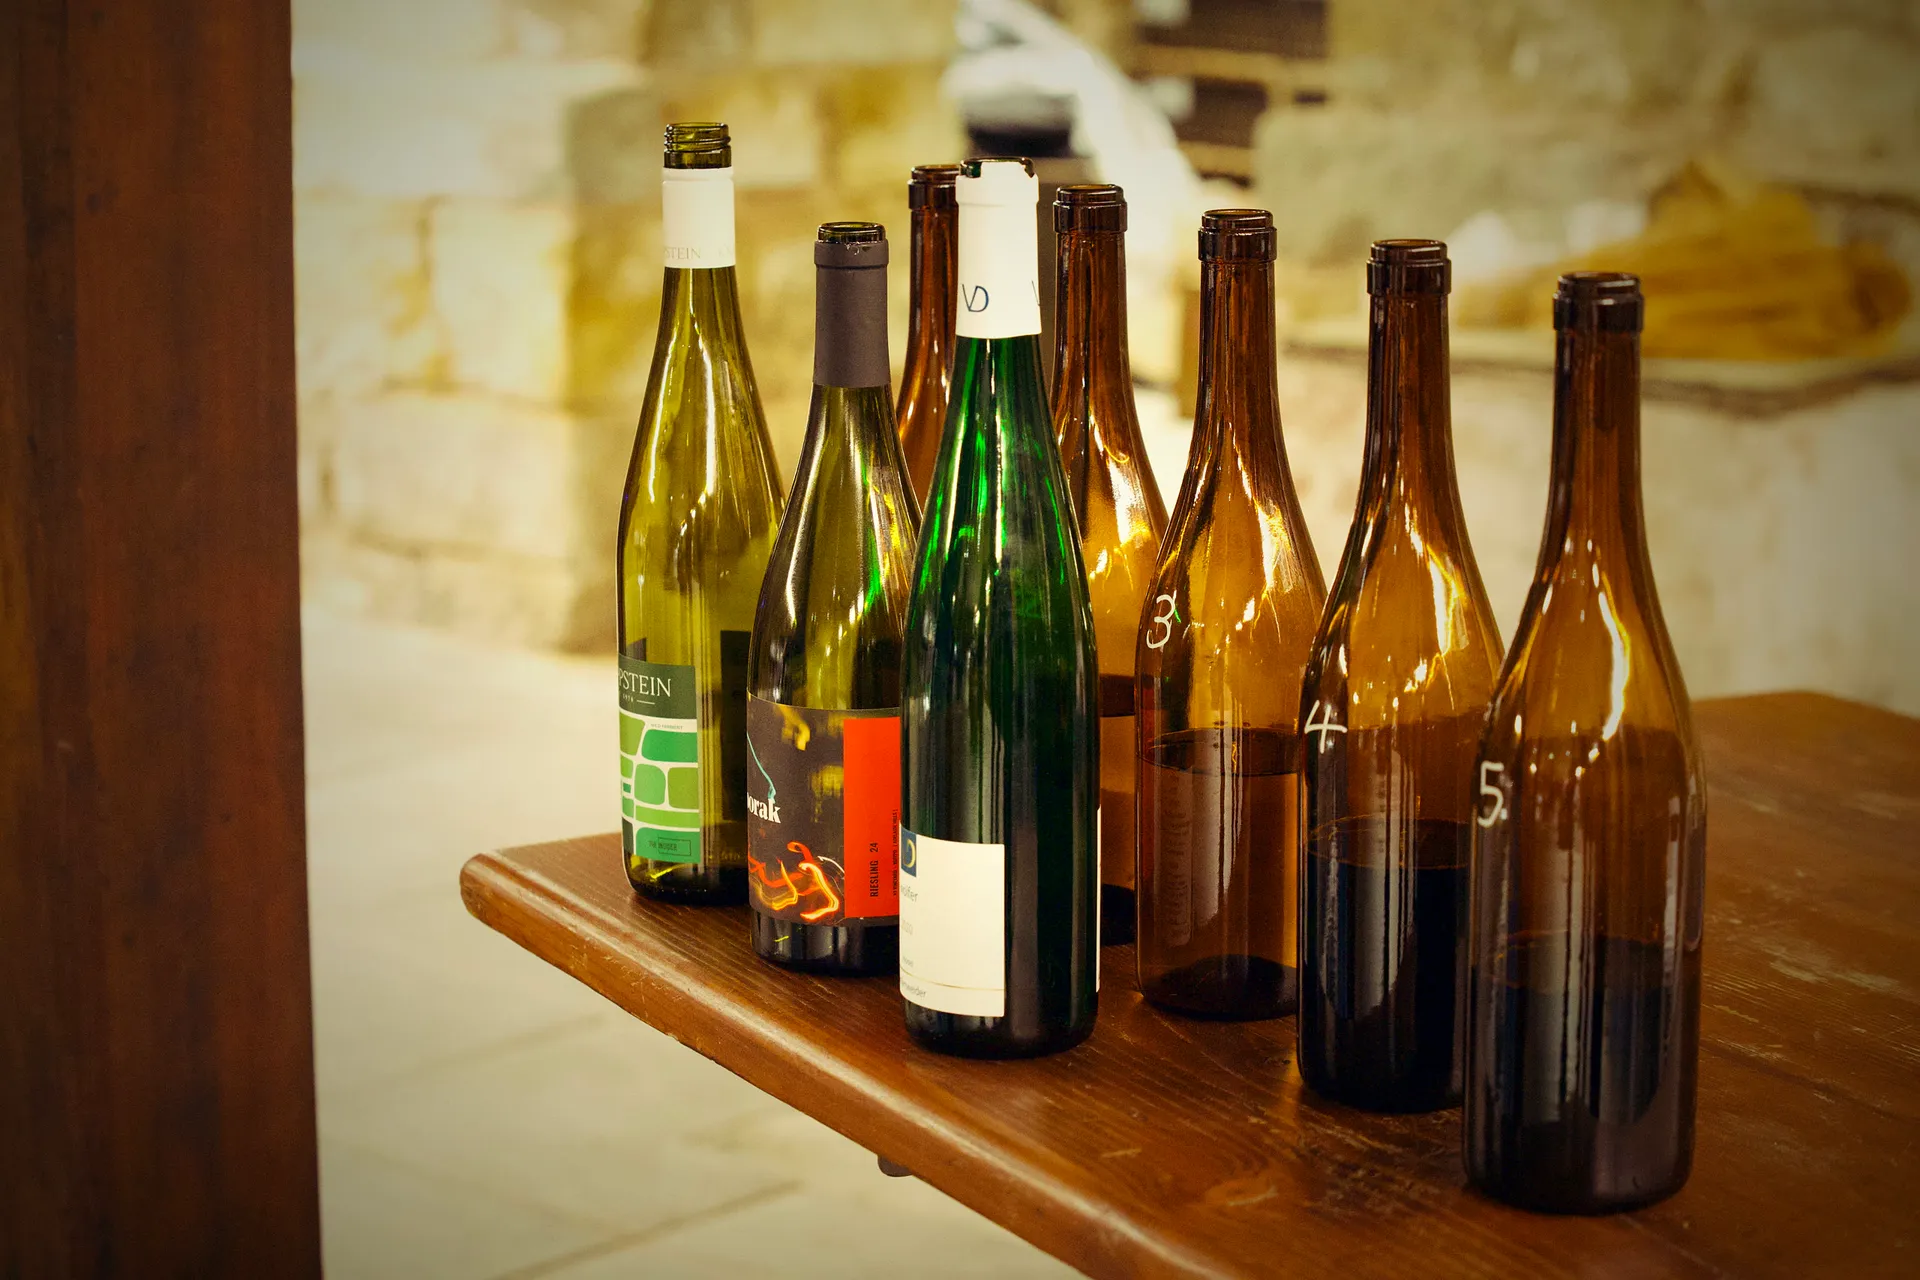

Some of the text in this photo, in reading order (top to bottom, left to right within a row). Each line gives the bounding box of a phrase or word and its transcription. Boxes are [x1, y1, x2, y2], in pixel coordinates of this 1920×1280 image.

[1146, 594, 1176, 649] 3
[1304, 699, 1348, 754] 4
[869, 842, 879, 897] RIESLING 24
